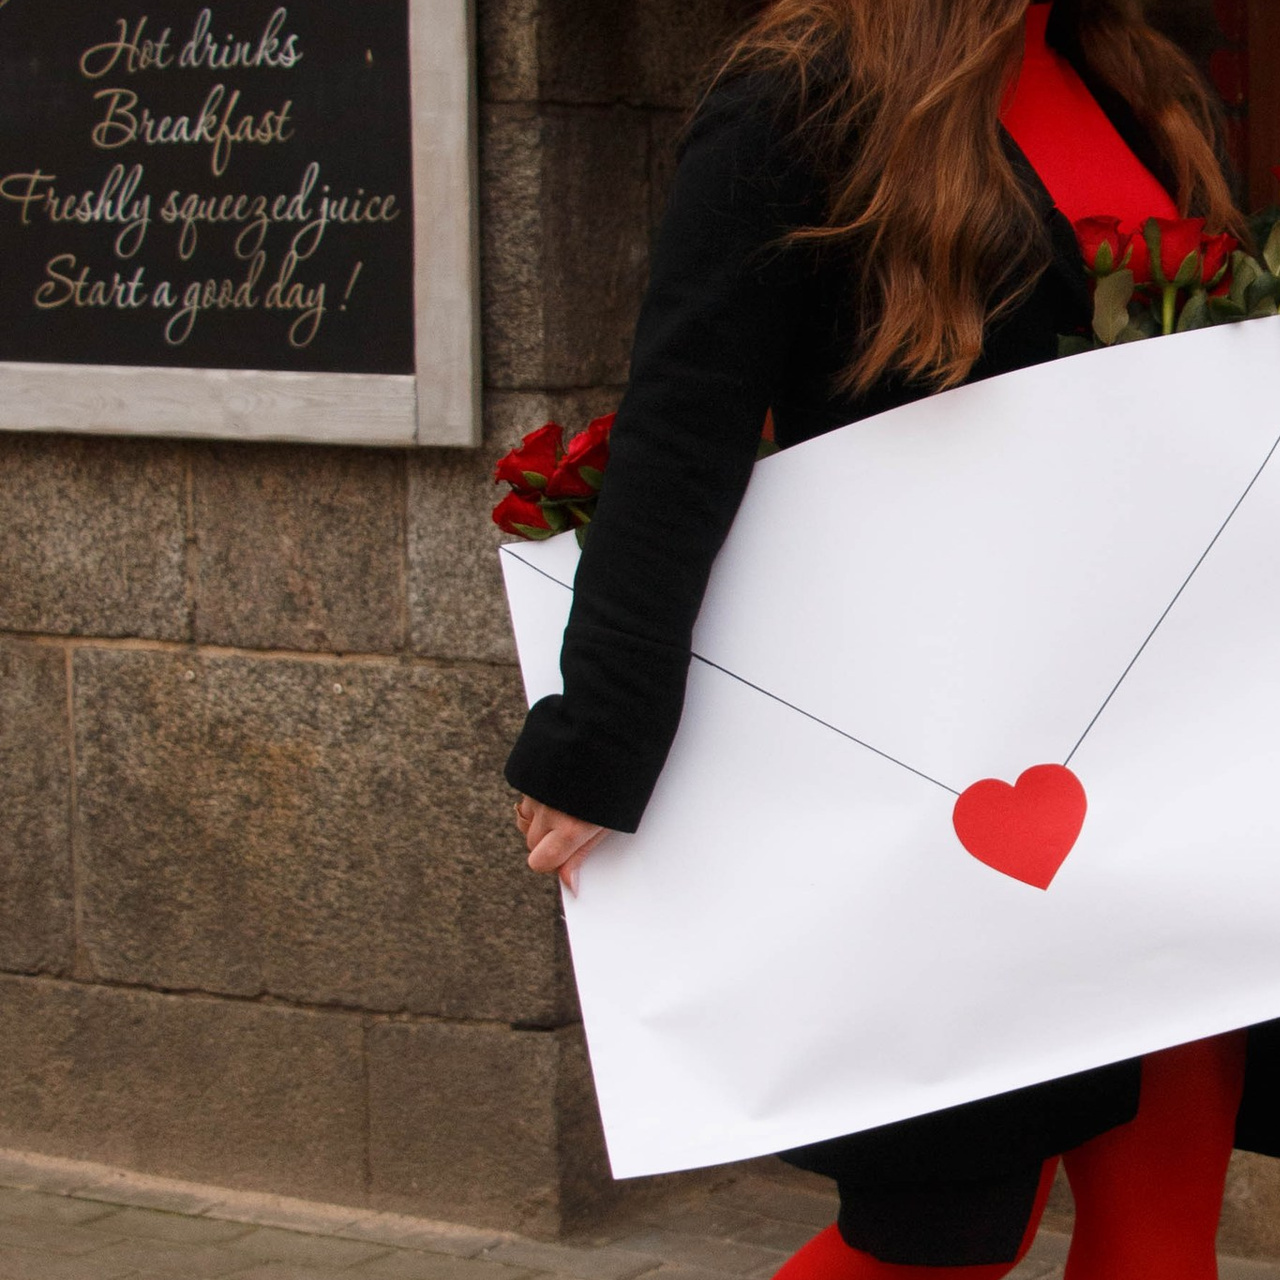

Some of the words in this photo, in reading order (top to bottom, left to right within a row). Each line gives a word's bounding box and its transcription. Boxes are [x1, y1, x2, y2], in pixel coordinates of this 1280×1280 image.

[80, 16, 174, 78] Hot
[179, 7, 303, 69] drinks
[92, 83, 295, 176] Breakfast
[0, 163, 153, 258] Freshly
[161, 162, 313, 260] squeezed
[292, 184, 400, 259] juice
[34, 253, 147, 310] Start
[152, 278, 176, 309] a
[165, 250, 266, 345] good
